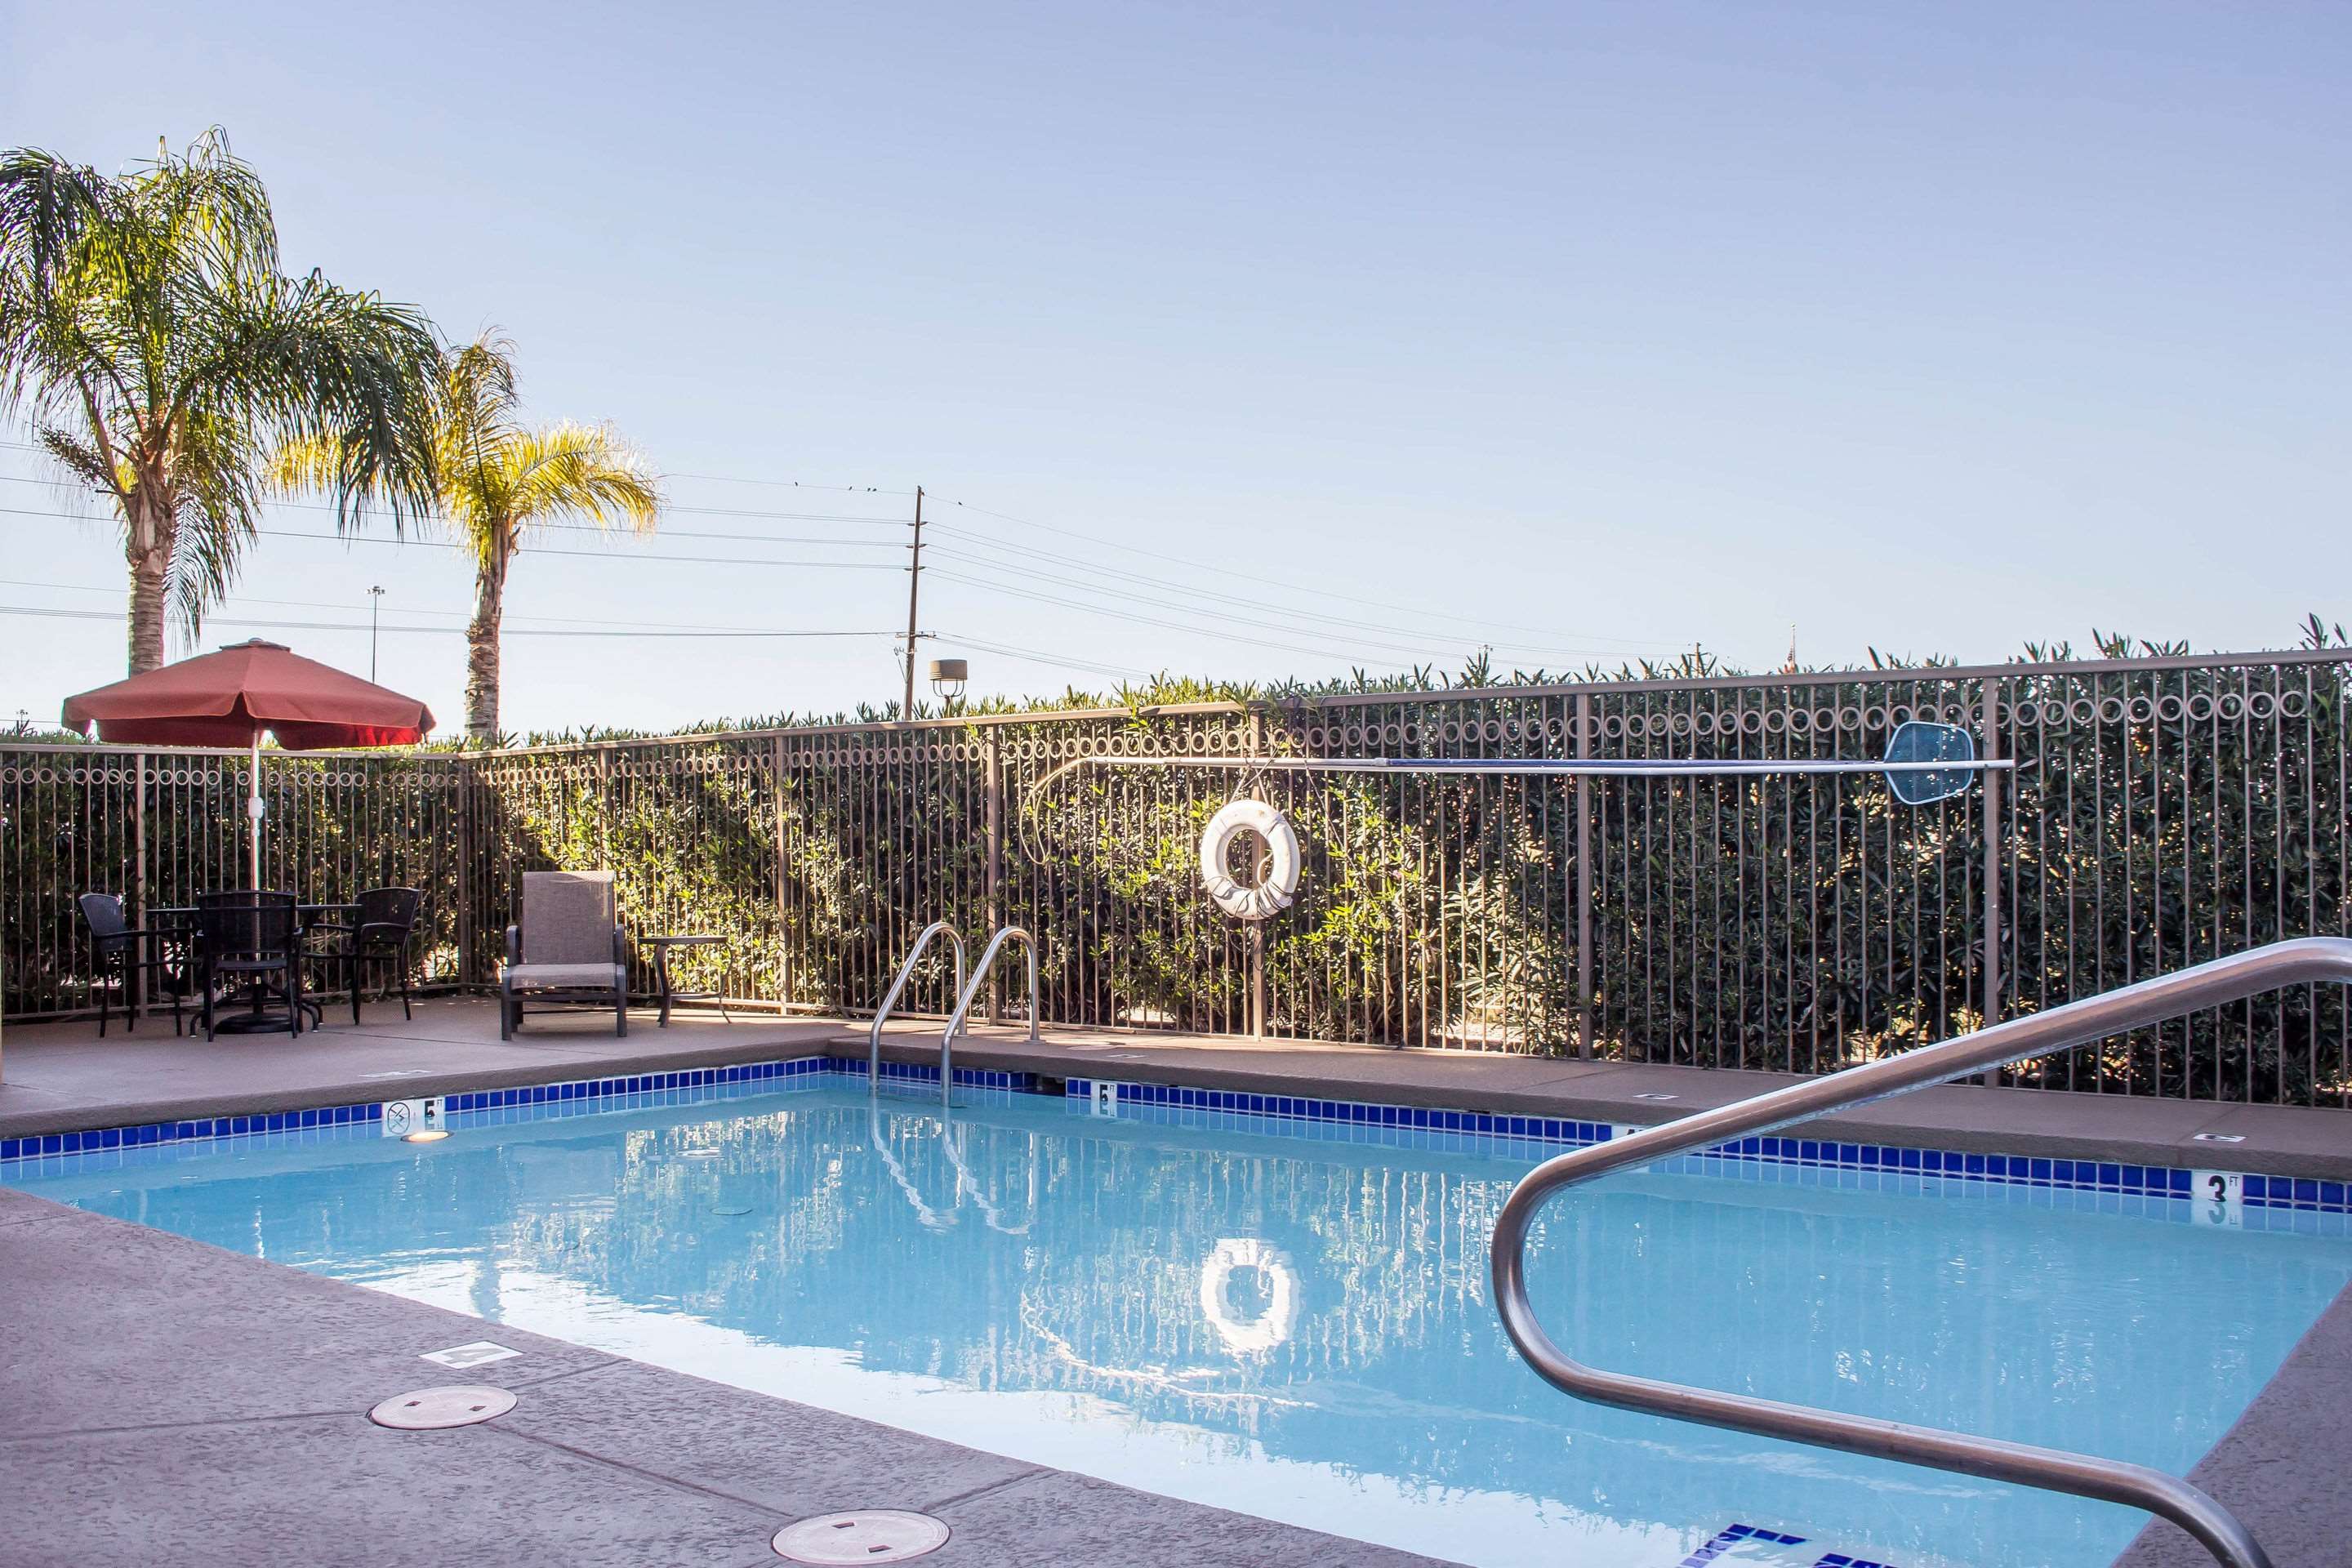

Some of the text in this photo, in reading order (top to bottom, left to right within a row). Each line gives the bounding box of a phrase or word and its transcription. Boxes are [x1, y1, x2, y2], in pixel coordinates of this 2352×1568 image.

[1098, 1084, 1108, 1102] 5
[425, 1100, 435, 1117] 5
[2208, 1175, 2238, 1203] 3 FT
